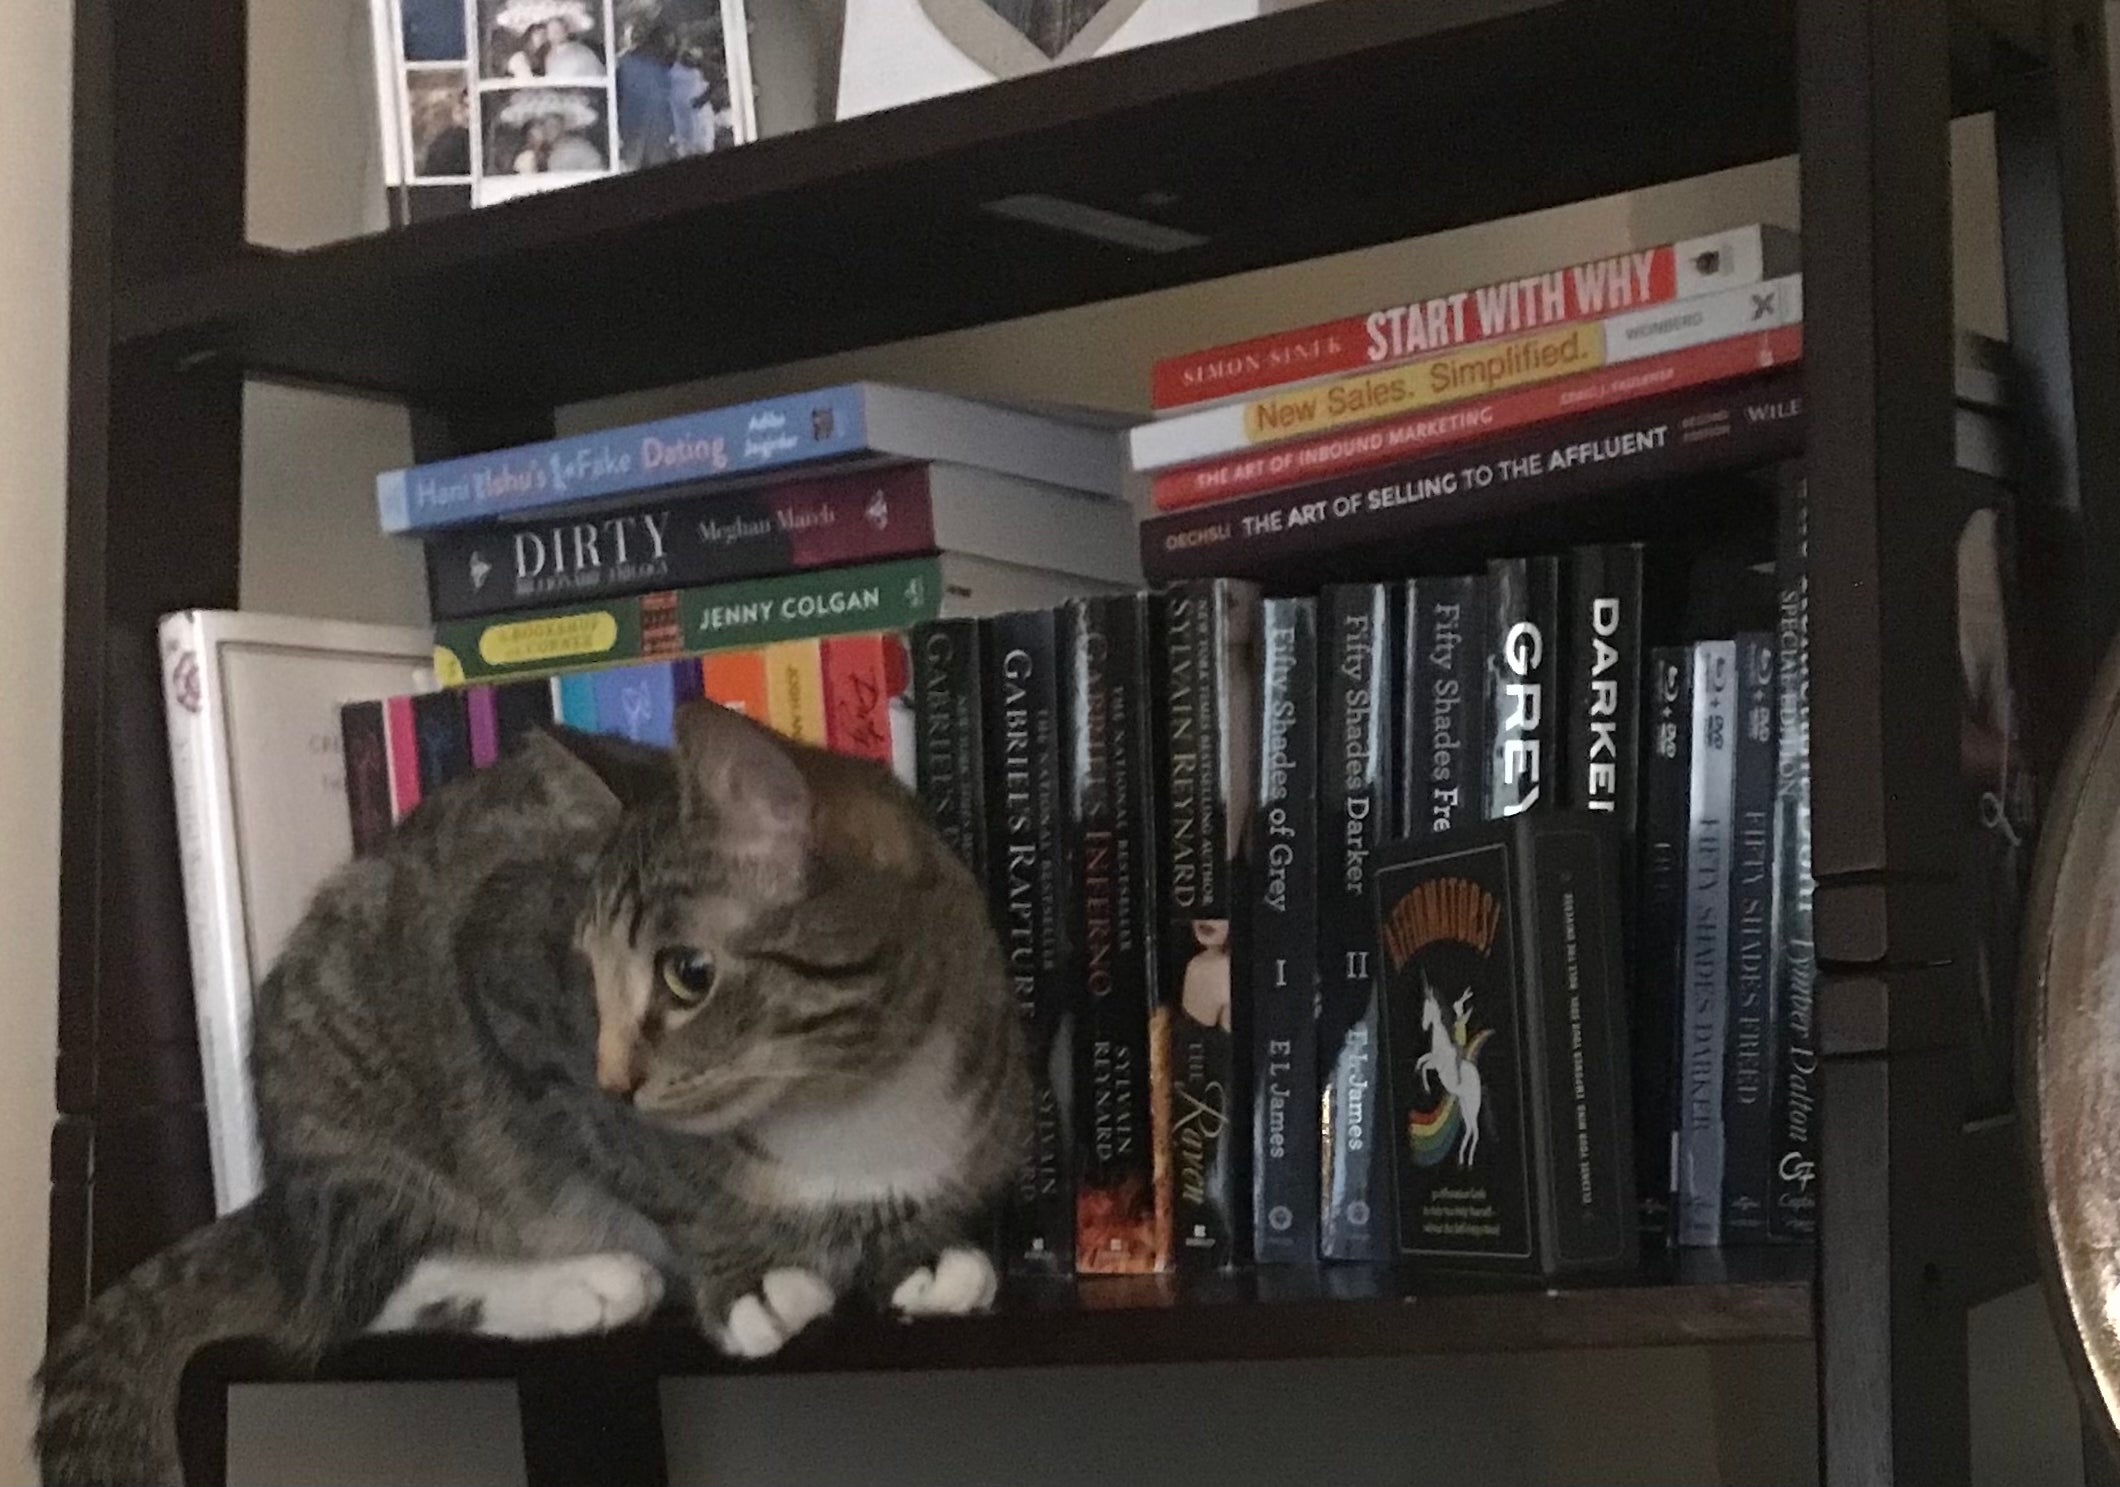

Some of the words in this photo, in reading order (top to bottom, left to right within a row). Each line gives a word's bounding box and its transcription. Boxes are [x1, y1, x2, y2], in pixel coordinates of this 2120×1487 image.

[1365, 293, 1470, 362] START
[1475, 270, 1566, 336] WITH
[1573, 249, 1655, 314] WHY
[1183, 353, 1260, 386] SIMON
[1257, 402, 1316, 431] New
[1327, 378, 1415, 415] Sales.
[1430, 331, 1589, 392] Simplified.
[641, 434, 728, 470] Dating
[1197, 468, 1228, 486] THE
[1233, 459, 1265, 480] ART
[1269, 454, 1294, 473] OF
[1299, 433, 1383, 466] INBOUND
[1389, 406, 1494, 444] MARKETING
[1242, 510, 1283, 537] THE
[1288, 500, 1328, 527] ART
[1332, 492, 1363, 518] OF
[1367, 473, 1457, 510] SELLING
[1461, 465, 1494, 489] TO
[1498, 453, 1543, 481] THE
[1549, 425, 1668, 471] AFFLUENT
[514, 511, 670, 577] DIRTY
[698, 515, 771, 544] Meghan
[700, 602, 774, 630] JENNY
[781, 587, 880, 619] COLGAN
[1340, 614, 1369, 682] Fifty
[1429, 602, 1462, 671] Fifty
[1779, 590, 1800, 692] SPECIAL
[1167, 598, 1195, 742] SYLVAIN
[1269, 626, 1297, 695] Fifty
[1003, 648, 1033, 835] GABRIEL'S
[1268, 700, 1297, 808] Shades
[1345, 688, 1371, 791] Shades
[1433, 678, 1462, 783] Shades
[1778, 695, 1799, 799] EDITION
[1199, 734, 1213, 835] BESTSELLING
[1269, 808, 1295, 840] of
[1173, 752, 1198, 909] REYNARD
[1200, 838, 1215, 907] AUTHOR
[1345, 797, 1370, 896] Darker
[1087, 831, 1112, 998] INFERNO
[1265, 844, 1294, 912] Grey
[1008, 844, 1036, 1018] RAPTURE
[1275, 959, 1287, 987] I
[1346, 950, 1370, 980] II
[1692, 906, 1718, 1015] SHADES
[1739, 899, 1764, 1008] SHADES
[1188, 1043, 1205, 1080] THE
[1270, 1040, 1291, 1056] E
[1270, 1060, 1290, 1078] L
[1346, 1029, 1368, 1047] E
[1690, 1023, 1719, 1132] DARKER
[1736, 1016, 1761, 1105] FREED
[1269, 1084, 1292, 1160] James
[1347, 1074, 1371, 1152] James
[1787, 1046, 1819, 1143] Dalton
[1173, 1080, 1231, 1205] Raven
